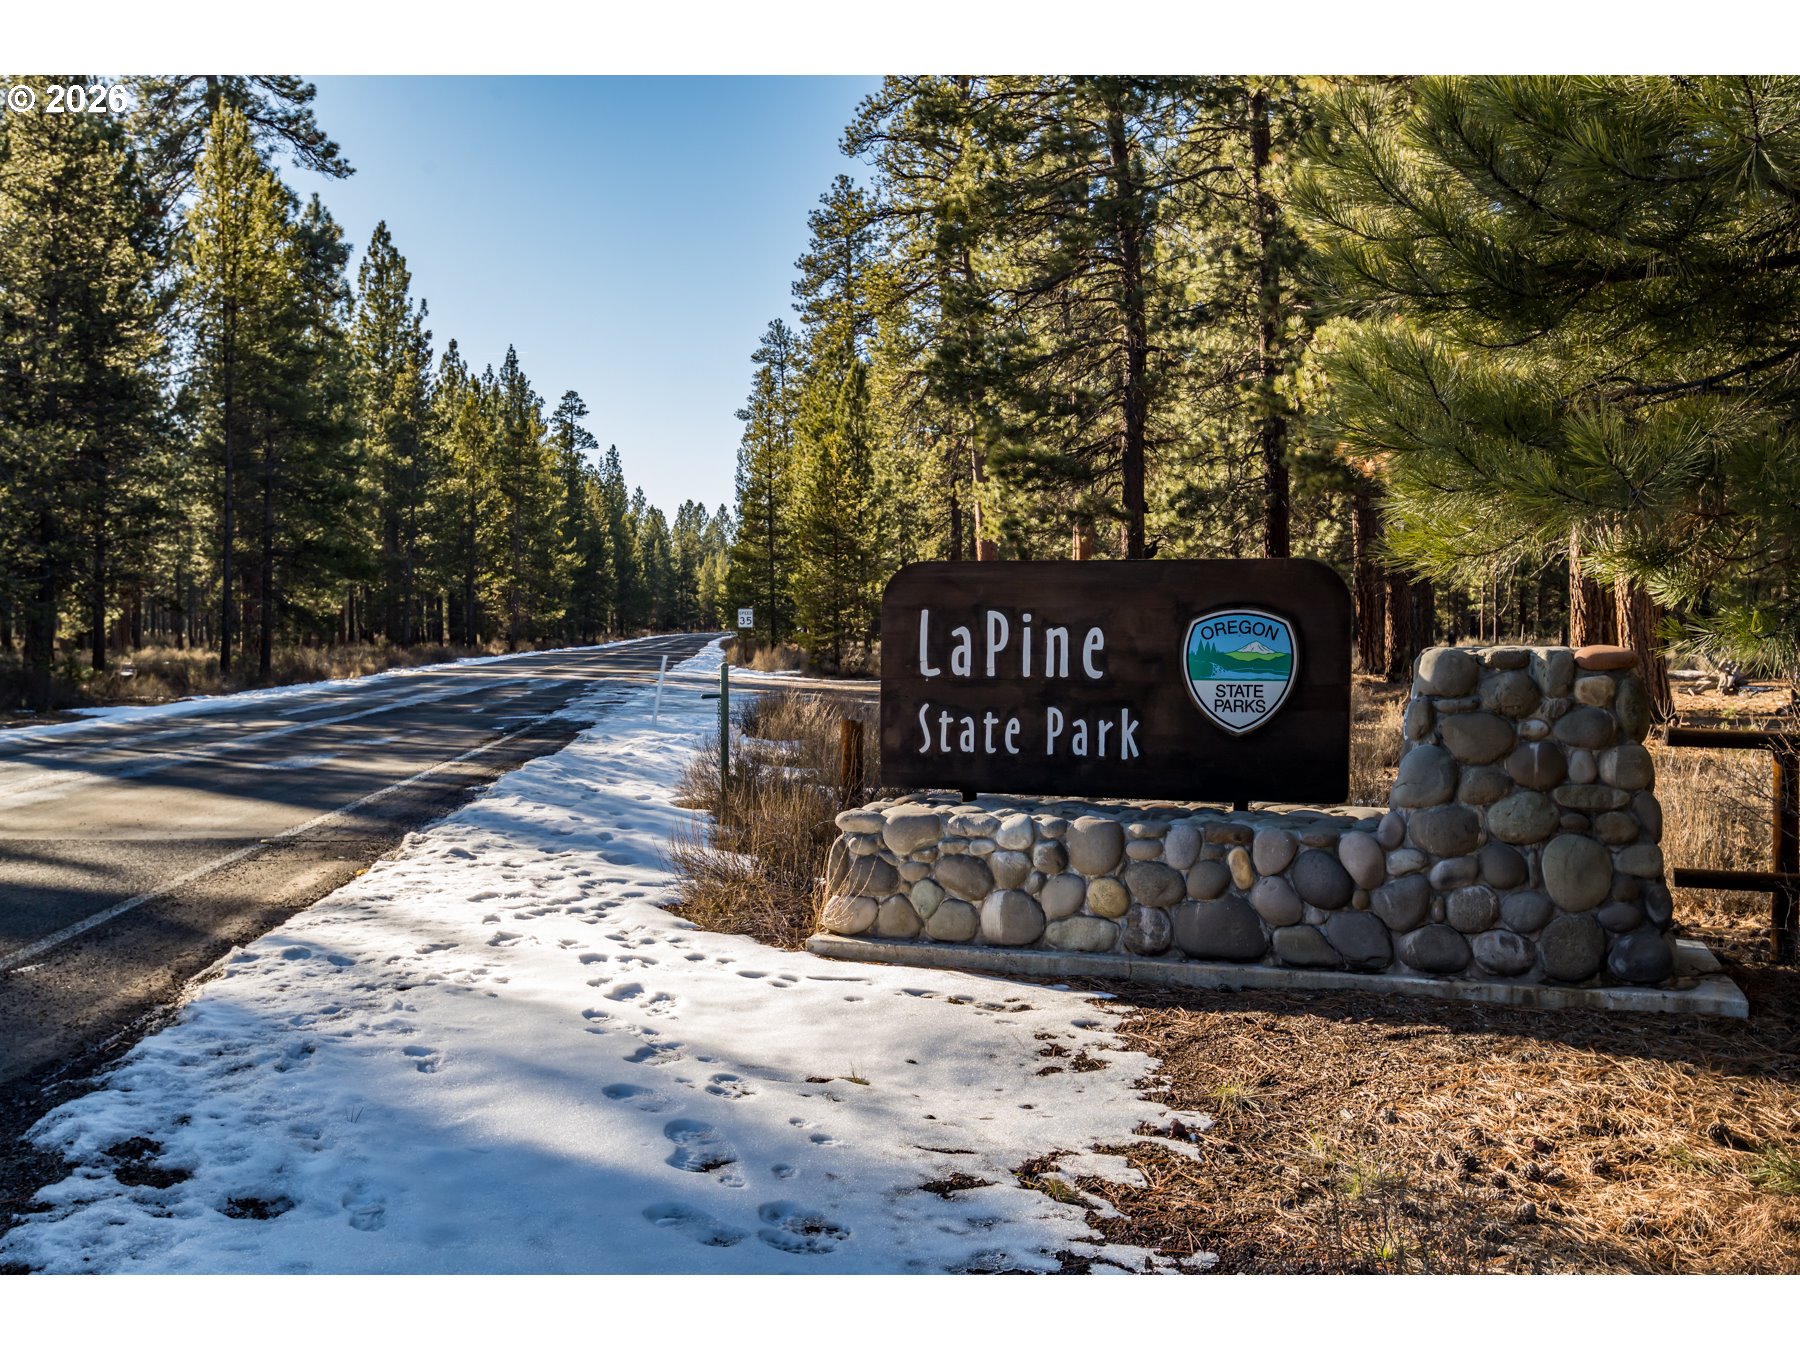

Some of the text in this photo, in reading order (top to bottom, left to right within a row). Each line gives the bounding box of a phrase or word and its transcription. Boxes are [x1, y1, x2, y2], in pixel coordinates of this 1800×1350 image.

[740, 616, 752, 625] 35
[1201, 620, 1279, 640] OREGON
[919, 609, 1104, 679] LaPine
[1215, 684, 1264, 698] STATE
[1214, 699, 1266, 713] PARKS
[918, 703, 1139, 760] State Park
